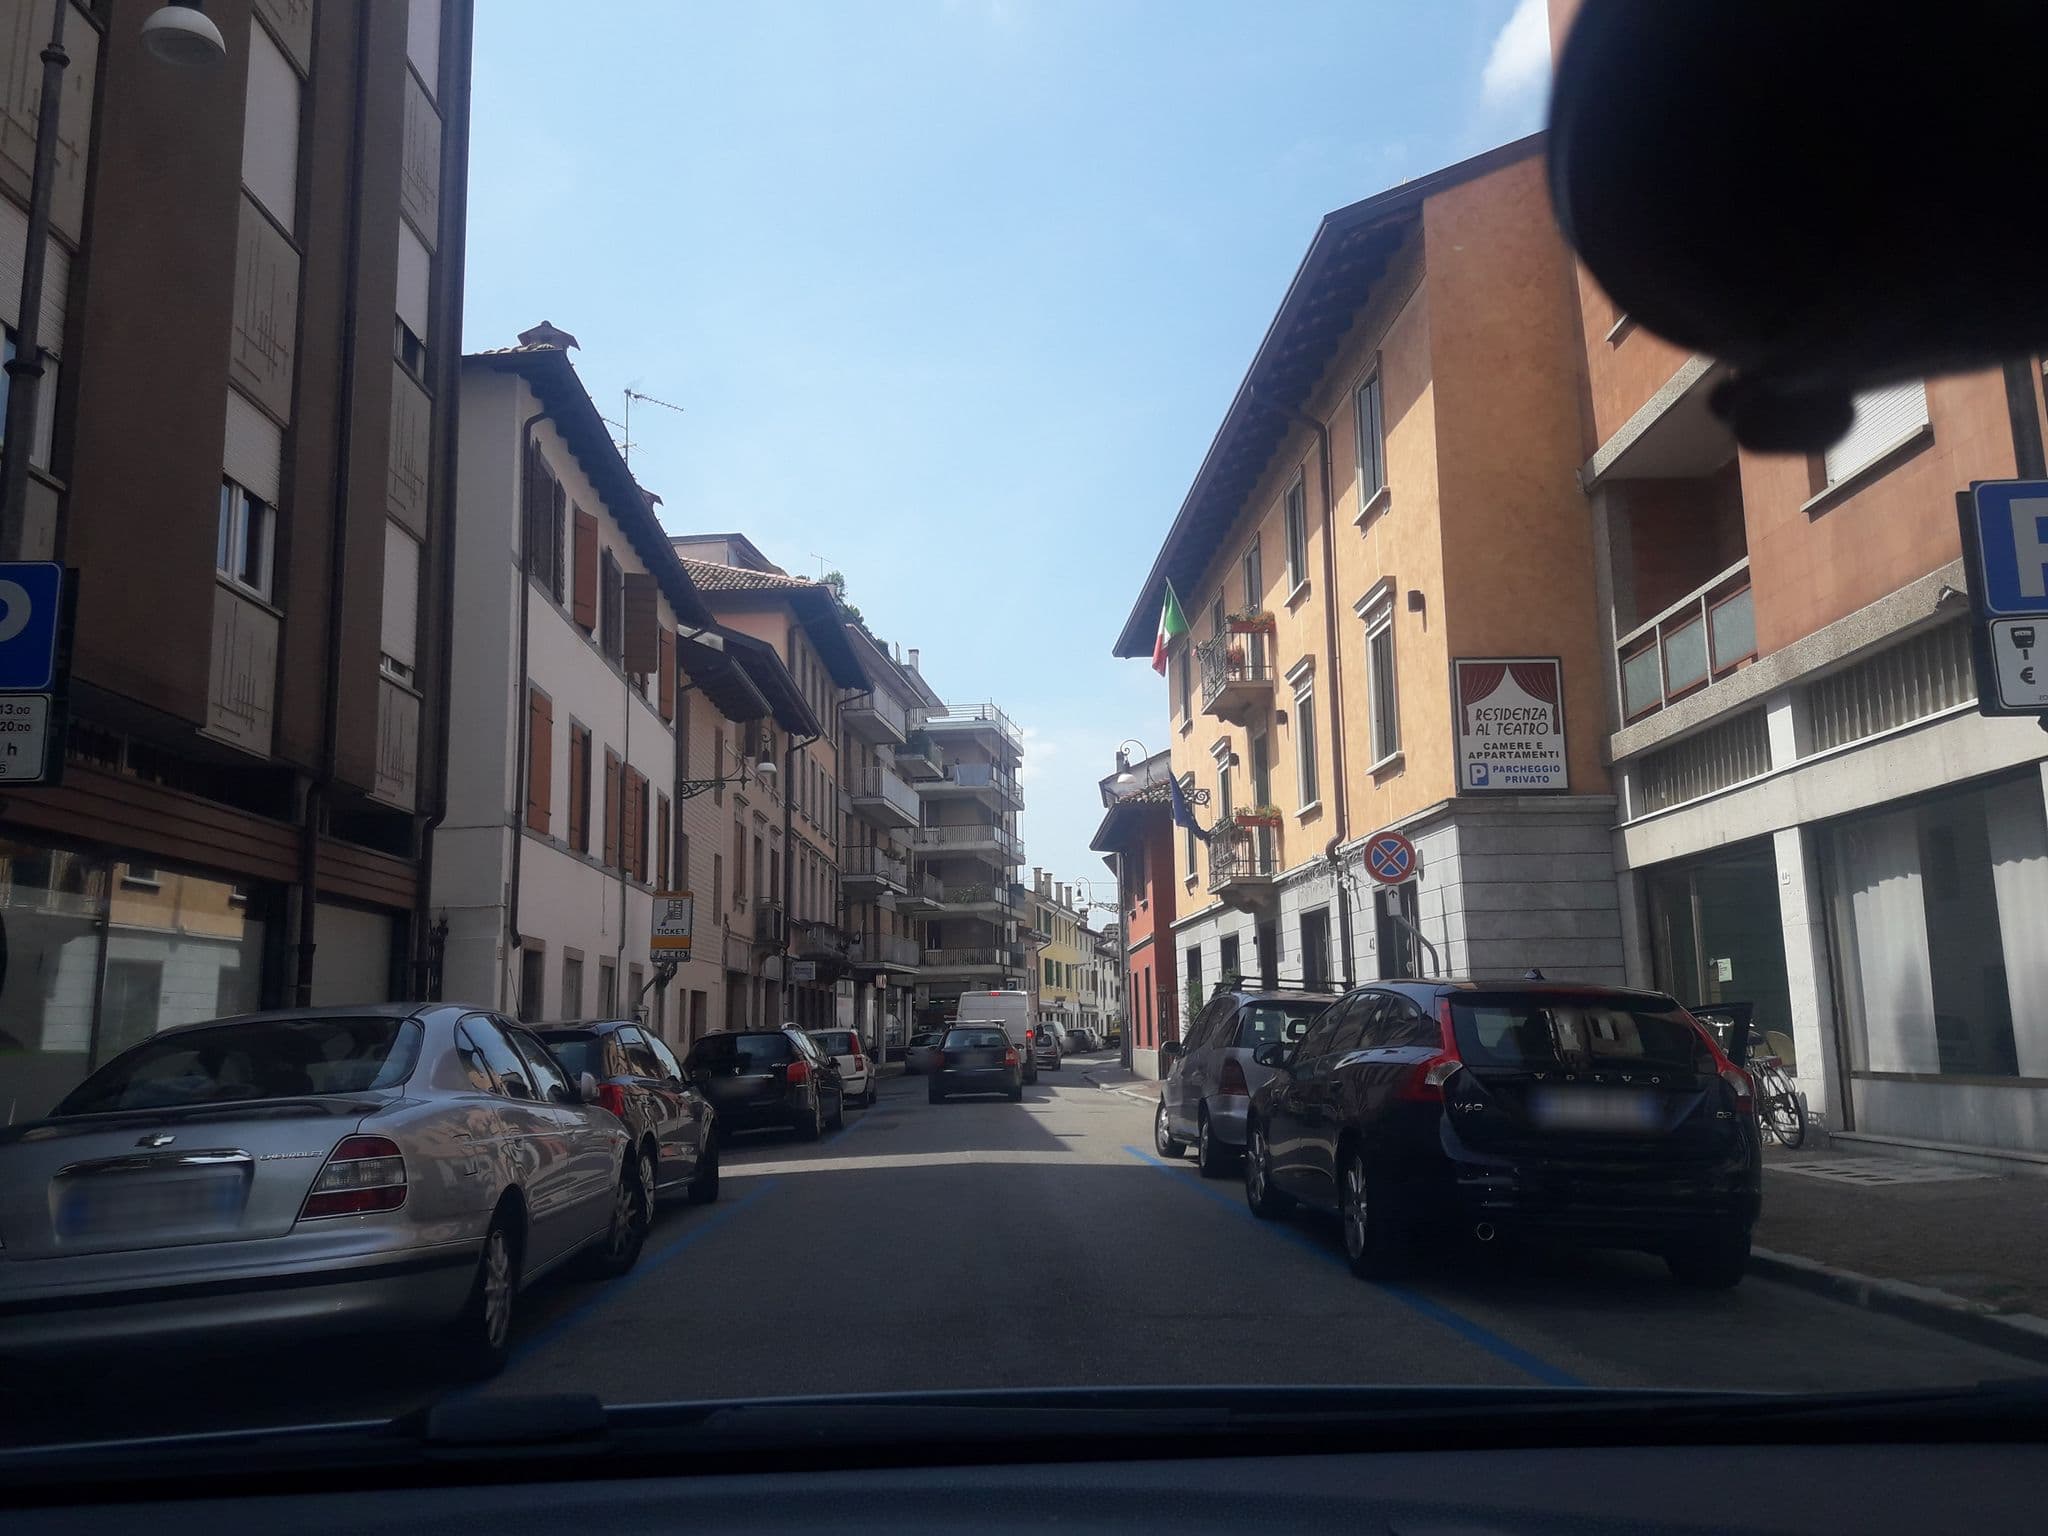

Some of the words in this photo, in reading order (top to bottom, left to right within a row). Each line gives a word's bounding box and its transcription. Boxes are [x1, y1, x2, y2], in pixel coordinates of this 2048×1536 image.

[1476, 708, 1547, 721] RESIDENZA
[1475, 723, 1491, 736] AL
[1497, 722, 1549, 736] TEATRO
[1483, 742, 1532, 750] CAMERE
[1536, 742, 1543, 750] E
[1468, 751, 1560, 759] APPARTAMENTI
[1493, 765, 1561, 773] PARCHEGGIO
[1534, 1072, 1661, 1084] VOLVO
[1454, 1103, 1484, 1113] V60
[259, 1150, 324, 1161] CHEVROLET
